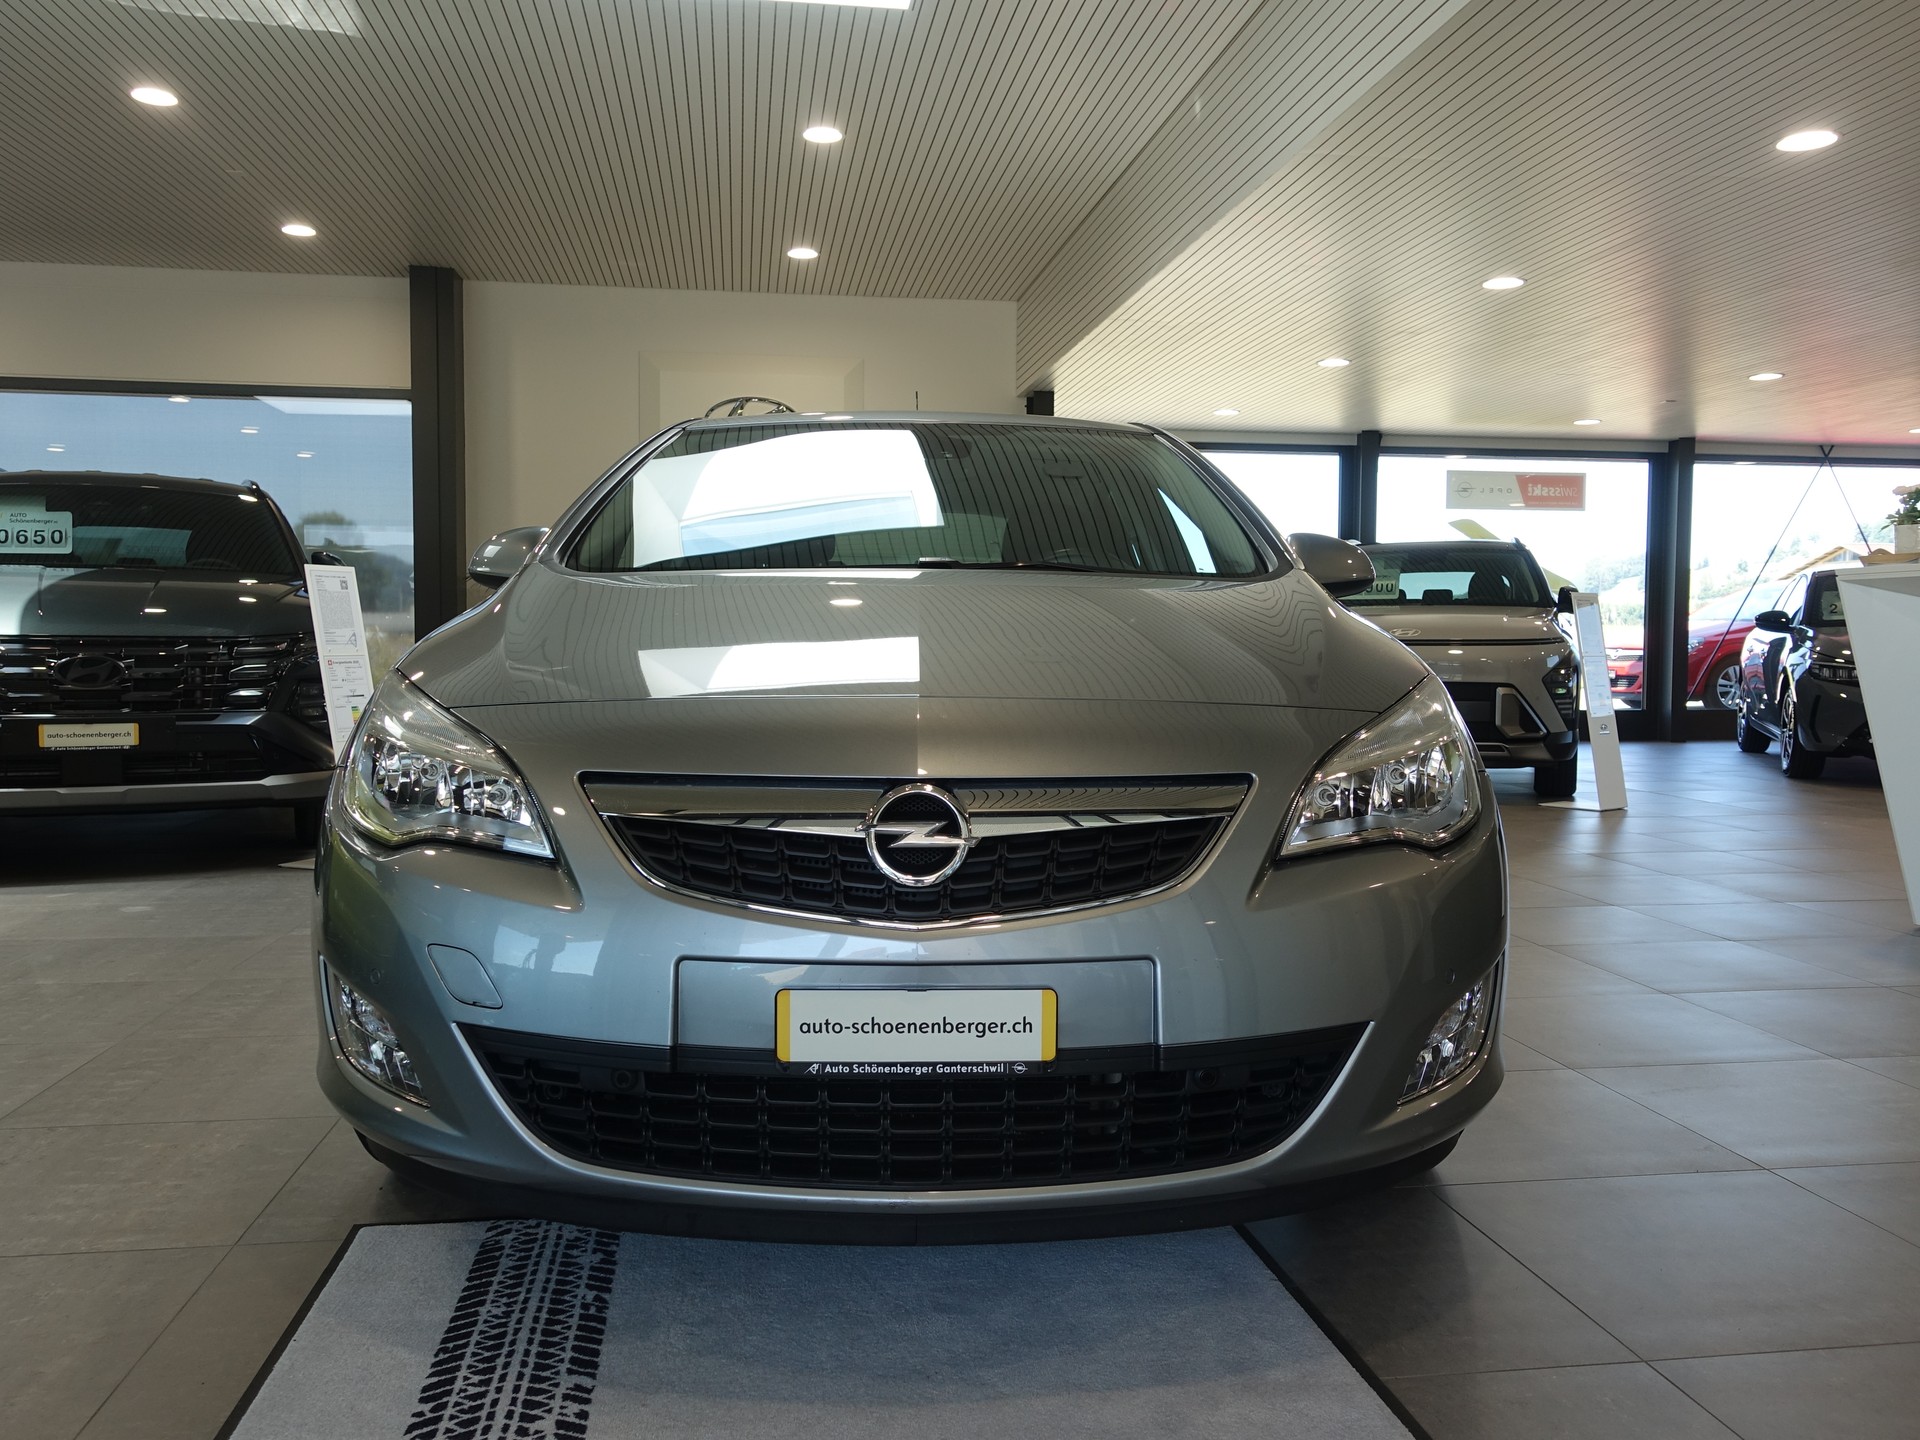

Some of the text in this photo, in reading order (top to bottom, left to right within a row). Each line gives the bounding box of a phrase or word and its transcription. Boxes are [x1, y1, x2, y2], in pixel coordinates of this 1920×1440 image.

[799, 1016, 1033, 1038] auto-schoenenberger.ch
[824, 1063, 1004, 1075] Auto Schönenberger Ganterschwil
